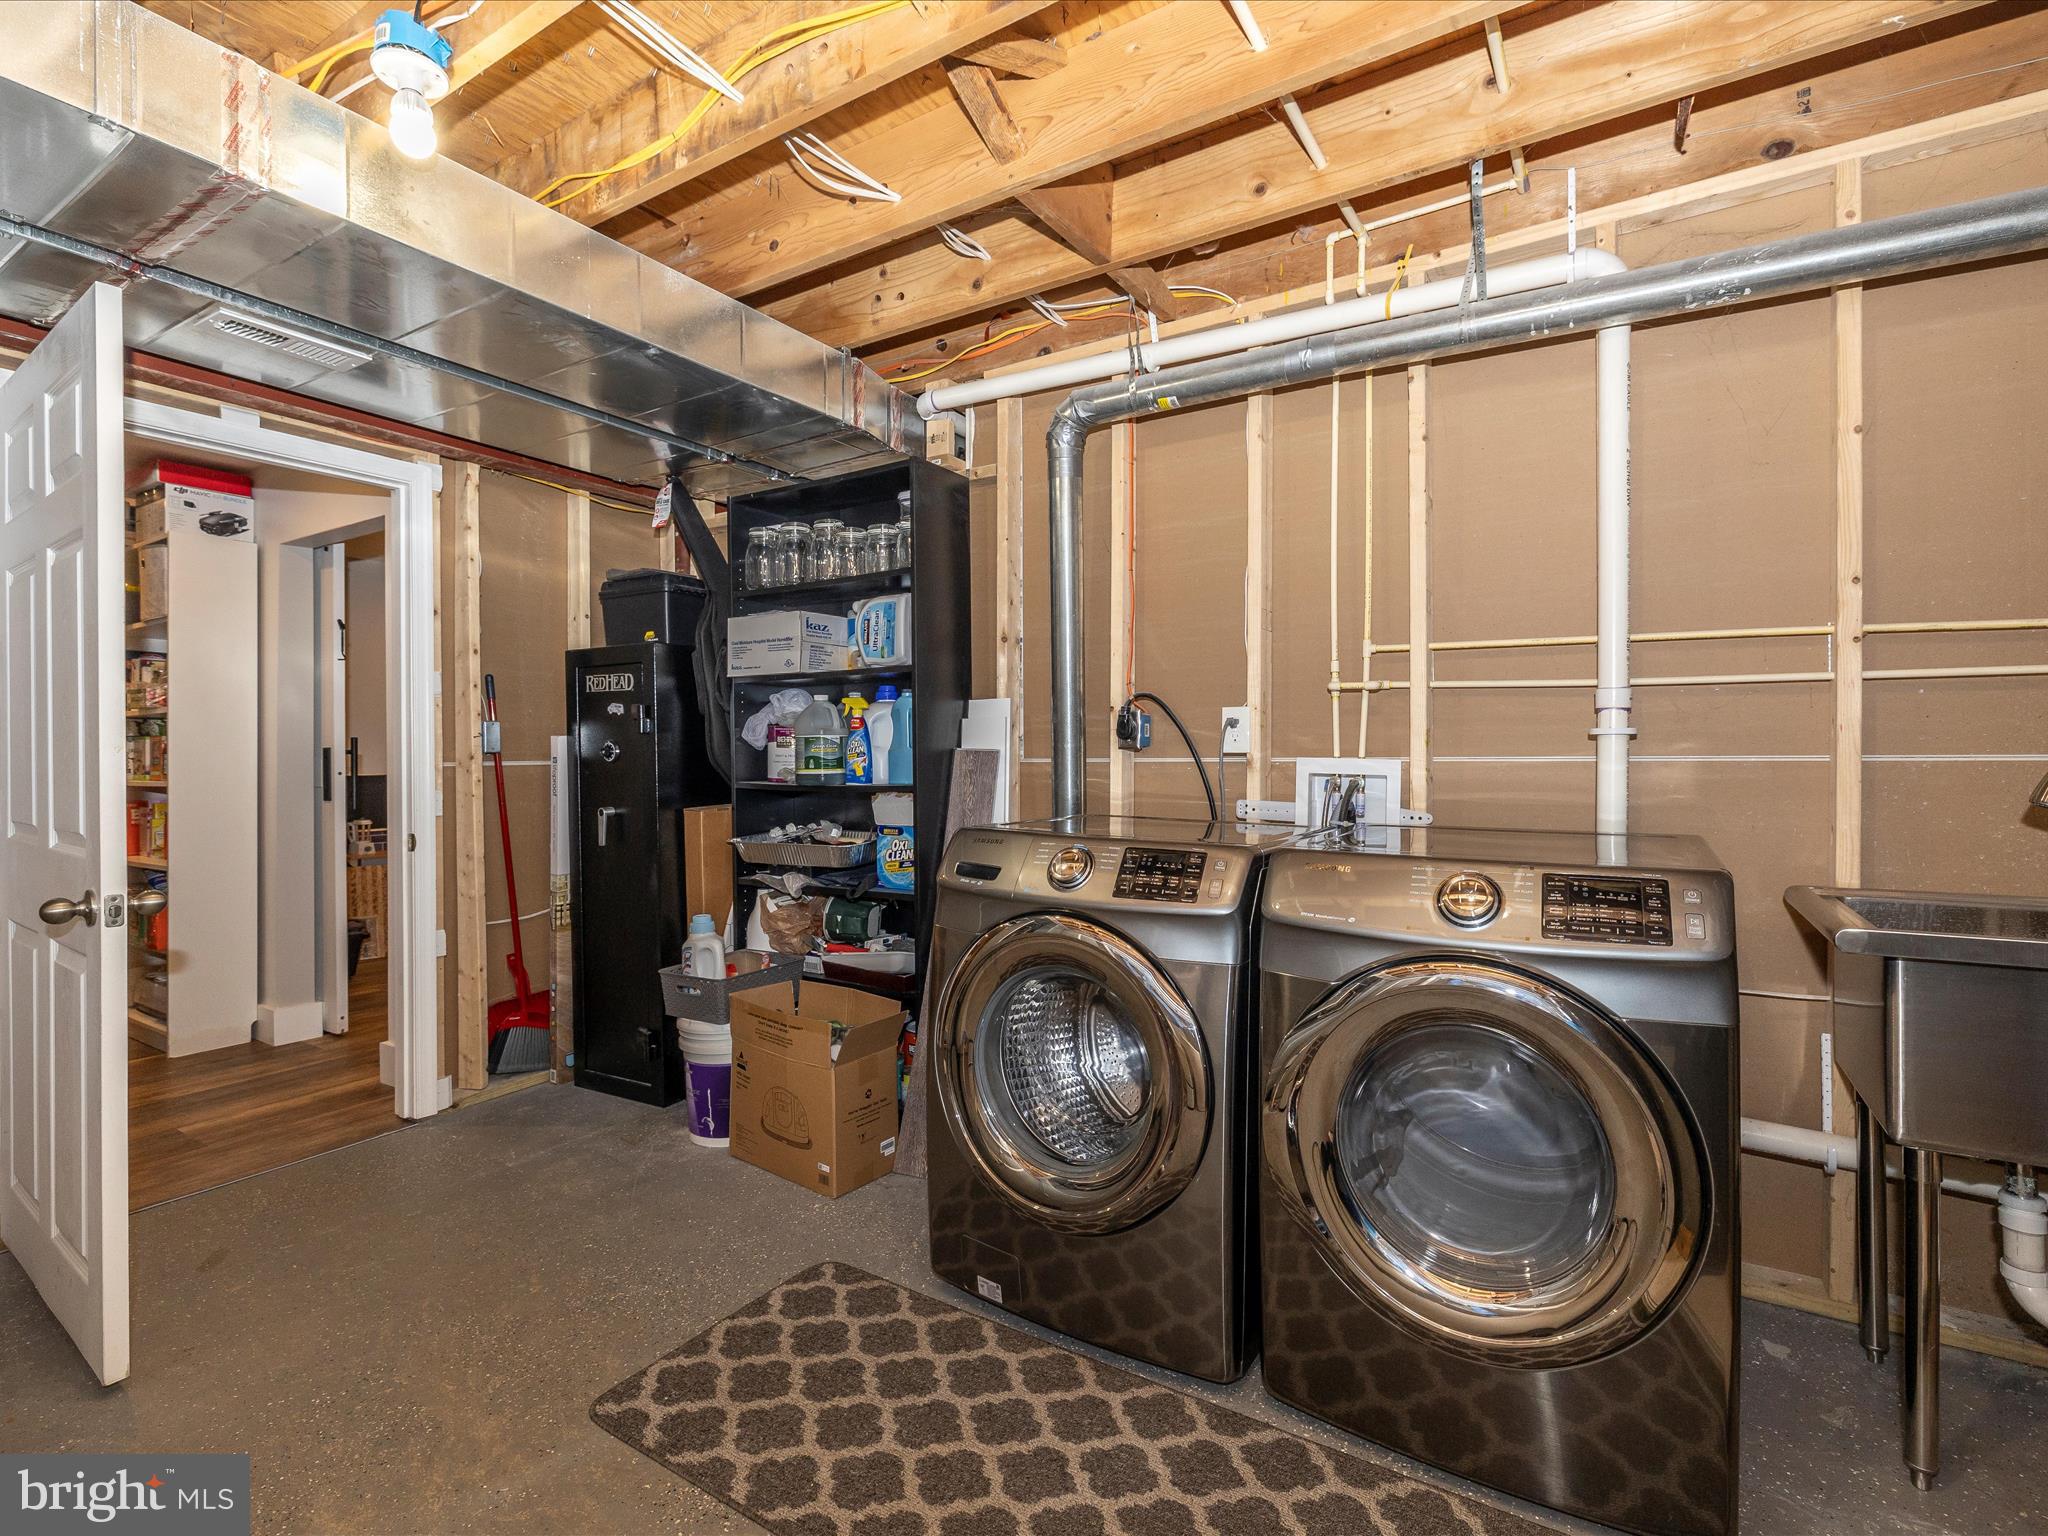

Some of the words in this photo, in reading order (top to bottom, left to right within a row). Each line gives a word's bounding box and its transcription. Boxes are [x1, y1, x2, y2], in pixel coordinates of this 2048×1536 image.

[173, 486, 188, 494] dji
[189, 490, 211, 498] MAVIC
[805, 616, 828, 632] kaz
[872, 609, 880, 652] UltraClean
[585, 673, 634, 693] REDHEAD
[892, 840, 908, 852] OXI
[886, 848, 914, 862] CLEAN
